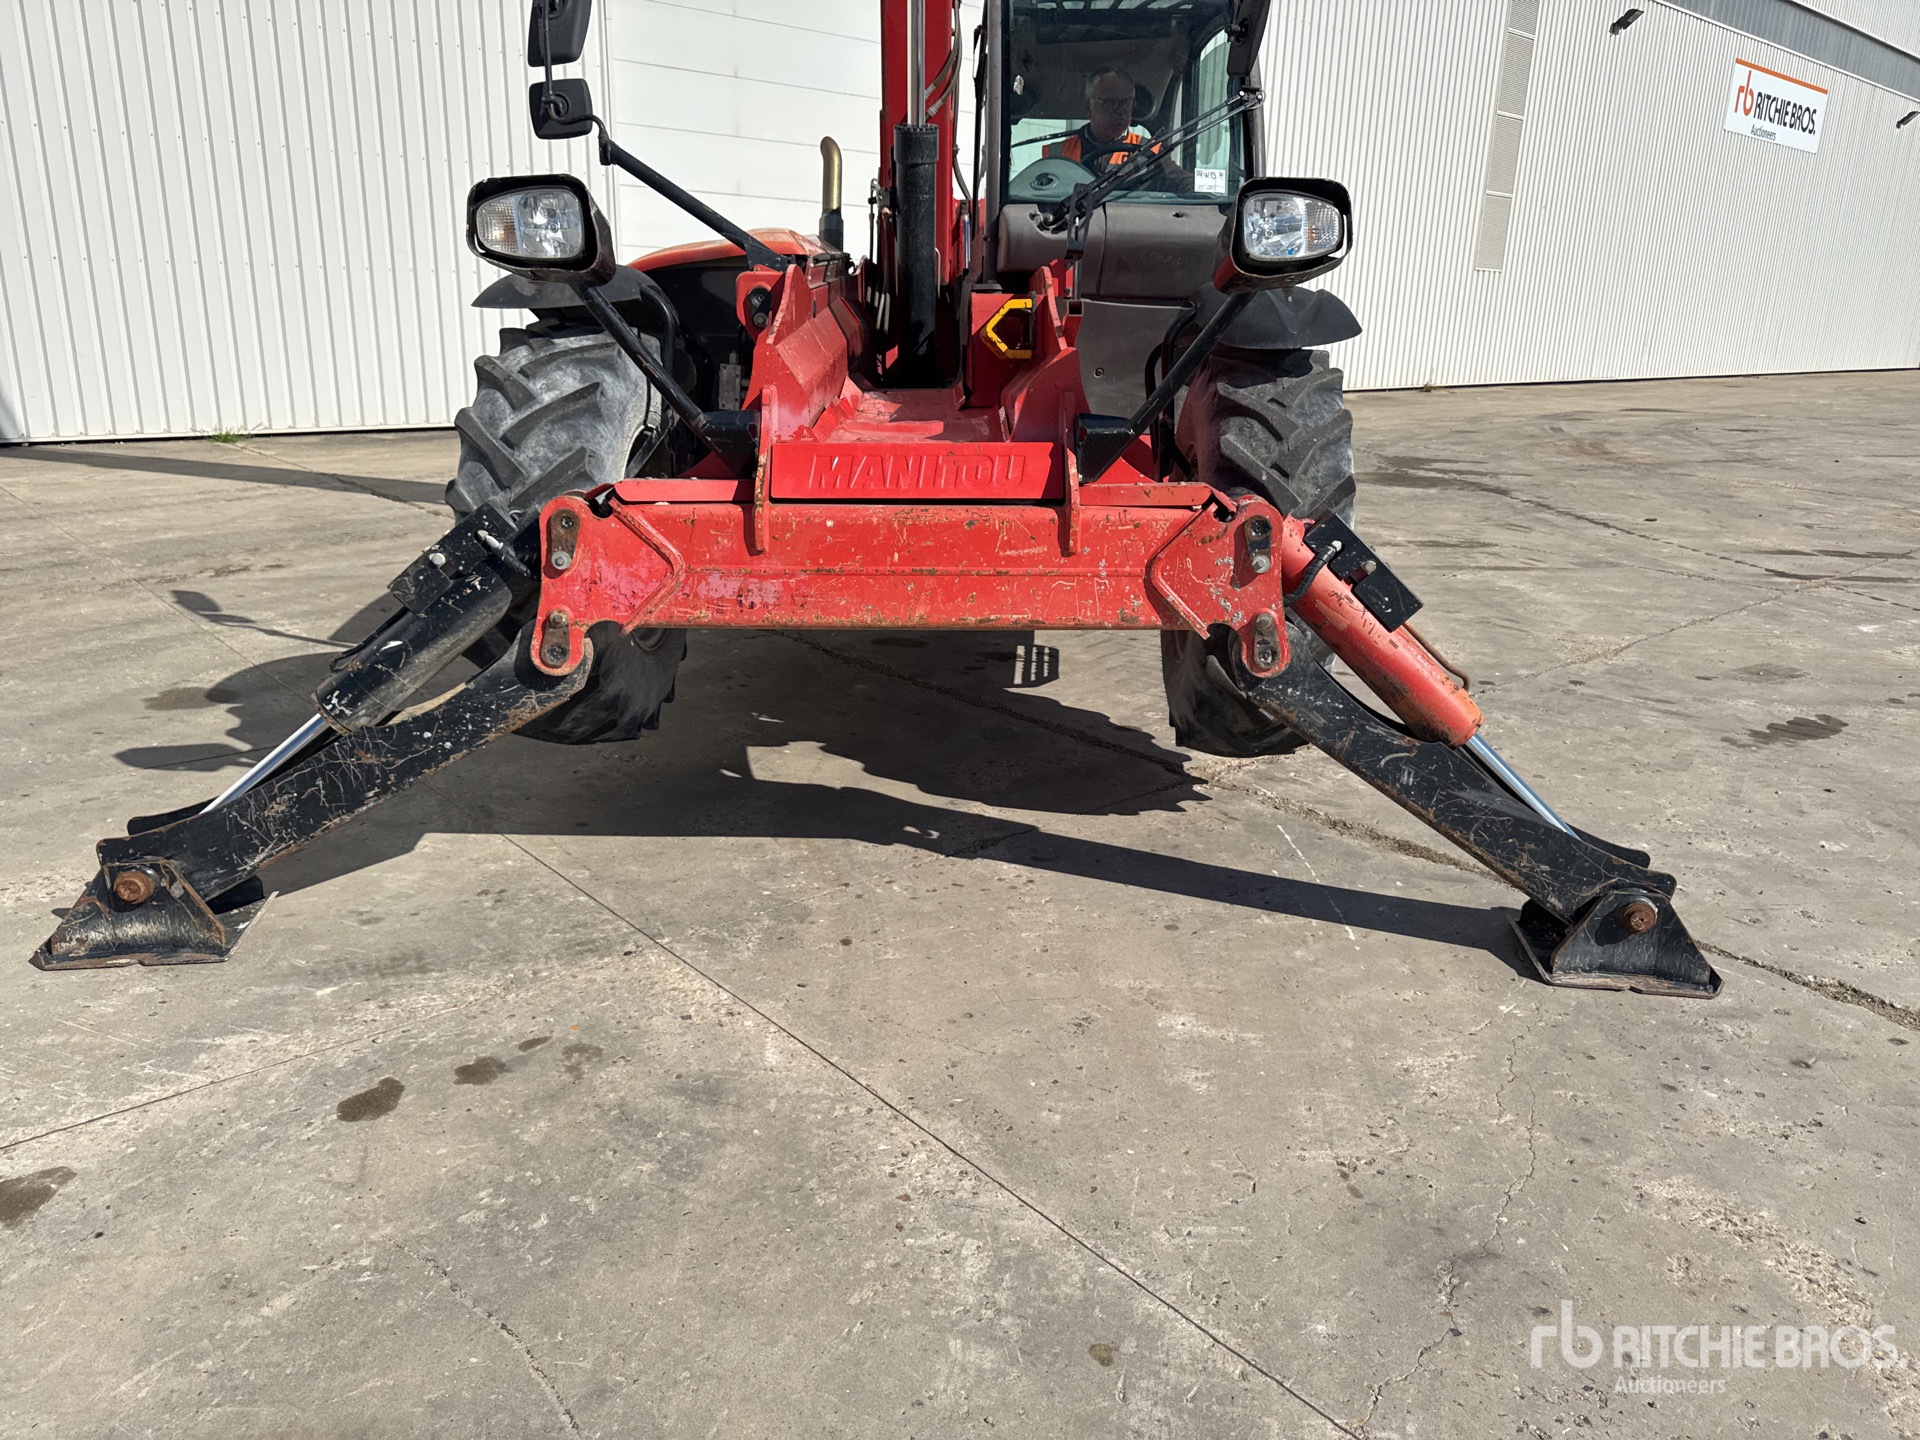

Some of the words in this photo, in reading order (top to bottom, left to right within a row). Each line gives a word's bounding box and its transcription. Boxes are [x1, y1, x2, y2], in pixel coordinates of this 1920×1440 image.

[1753, 91, 1791, 127] RITCHIE
[1789, 102, 1817, 135] BROS.
[1751, 124, 1776, 141] Auctioneers
[809, 454, 1026, 489] MANITOU
